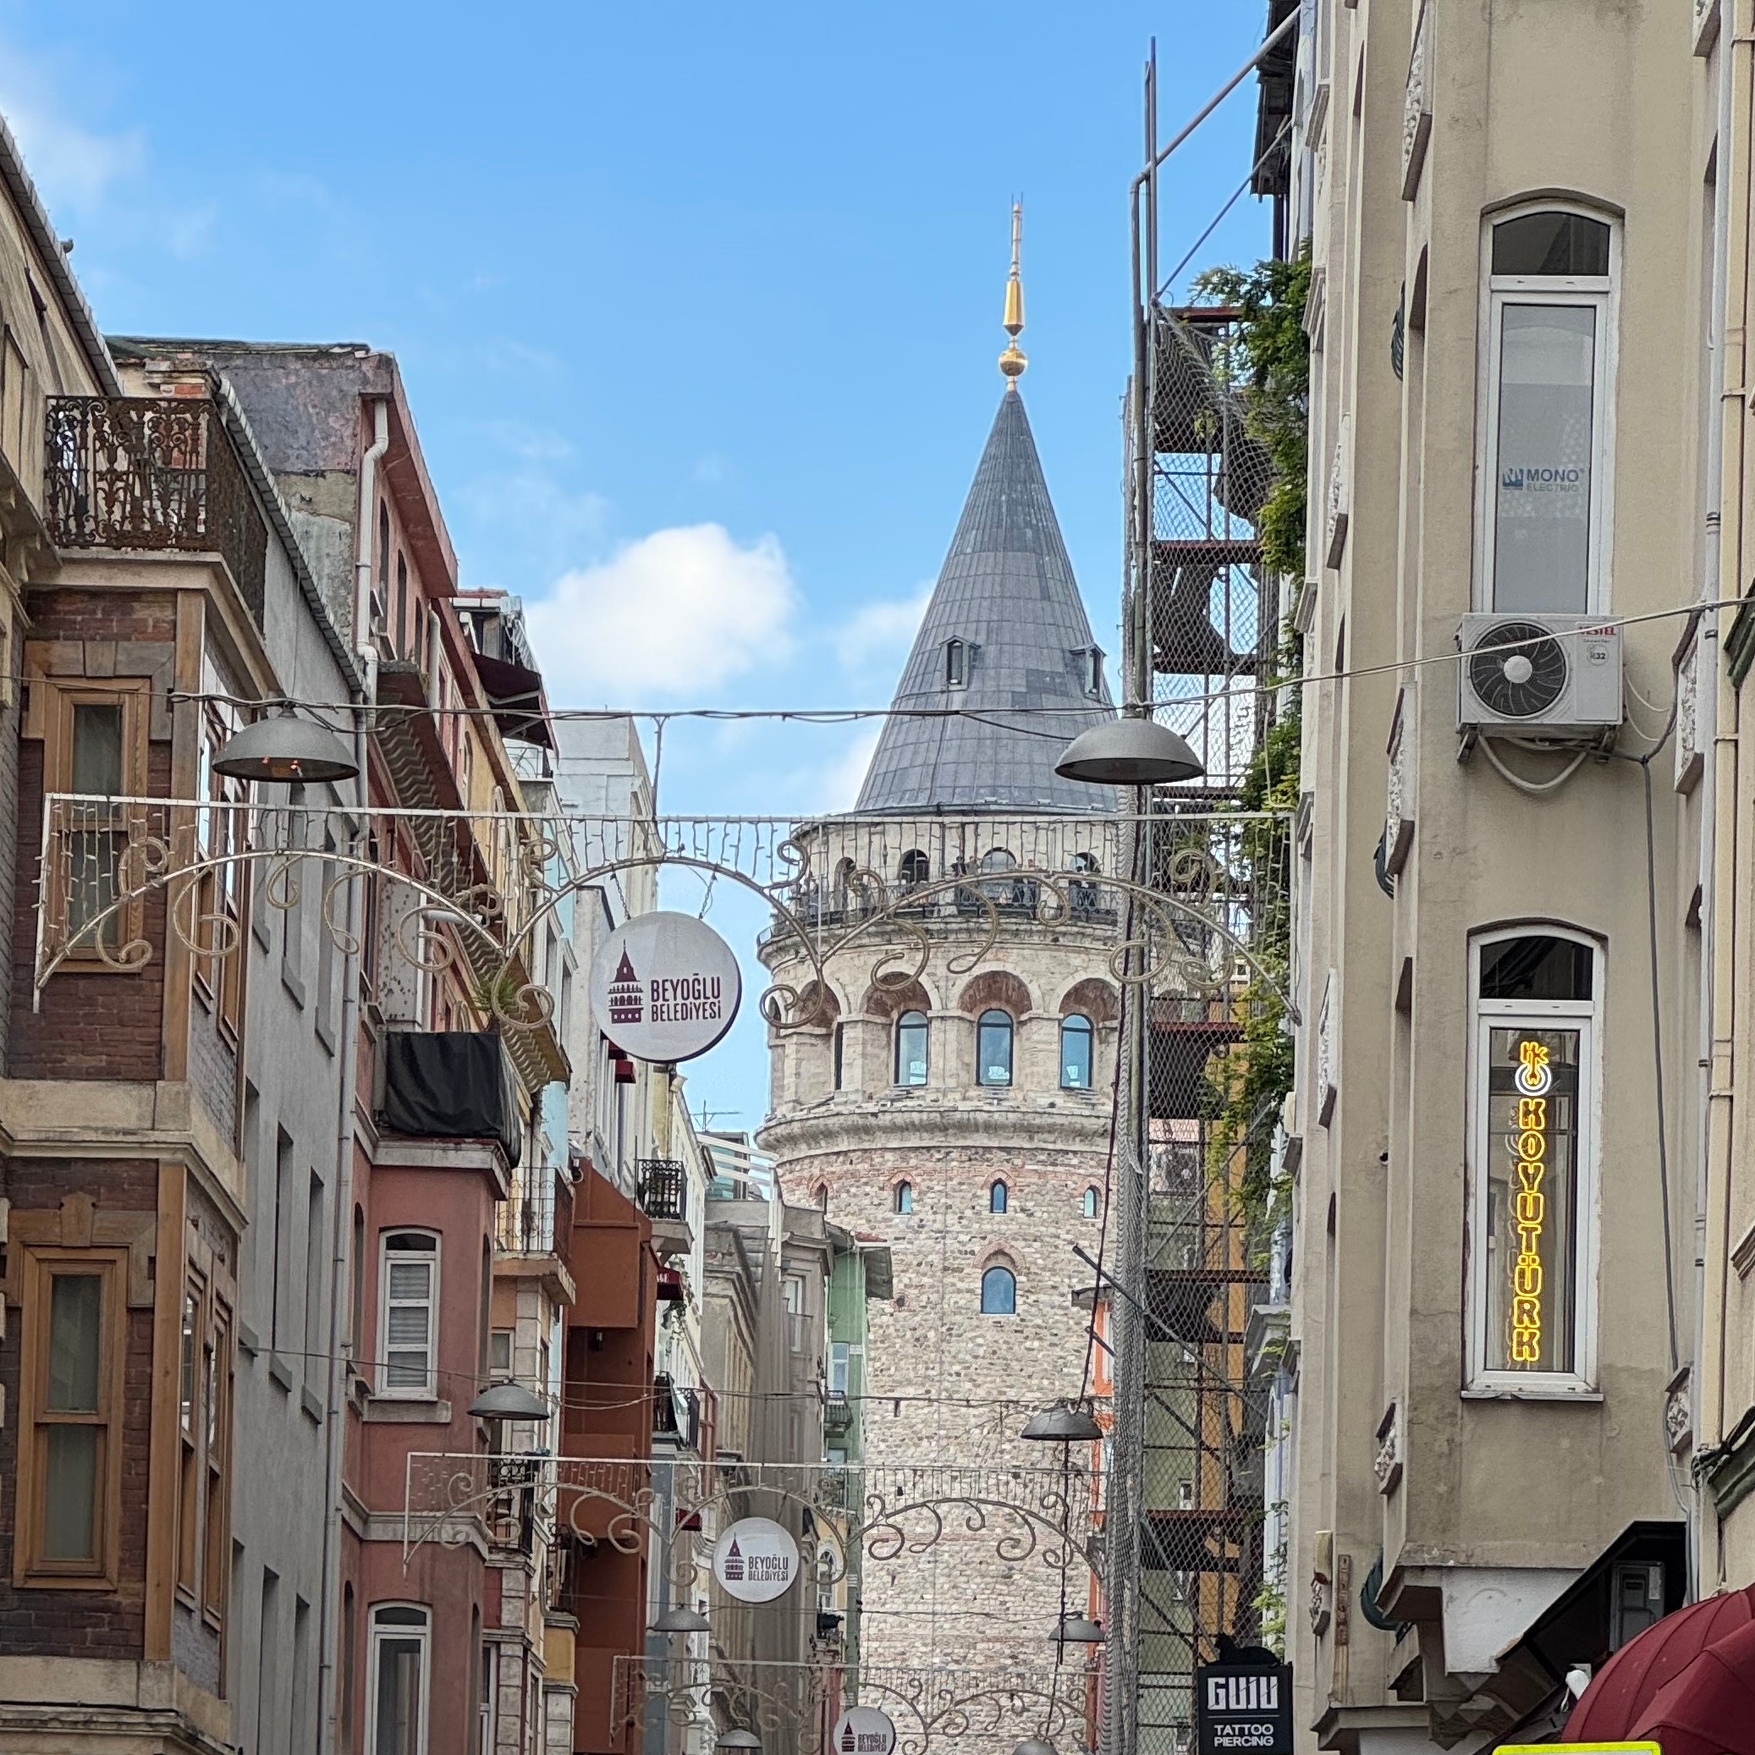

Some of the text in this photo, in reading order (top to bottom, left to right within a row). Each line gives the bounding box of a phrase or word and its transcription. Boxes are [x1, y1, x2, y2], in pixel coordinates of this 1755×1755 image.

[1526, 468, 1579, 482] MONO
[651, 973, 721, 1002] BEYOĞLU
[651, 1000, 721, 1022] BELEDİYESİ
[1513, 1098, 1546, 1362] KOYUTÜRK
[748, 1553, 789, 1570] BEYOĞLU
[748, 1569, 789, 1581] BELEDİYESİ
[1214, 1724, 1274, 1735] TATTOO
[1214, 1736, 1274, 1747] PIERCING
